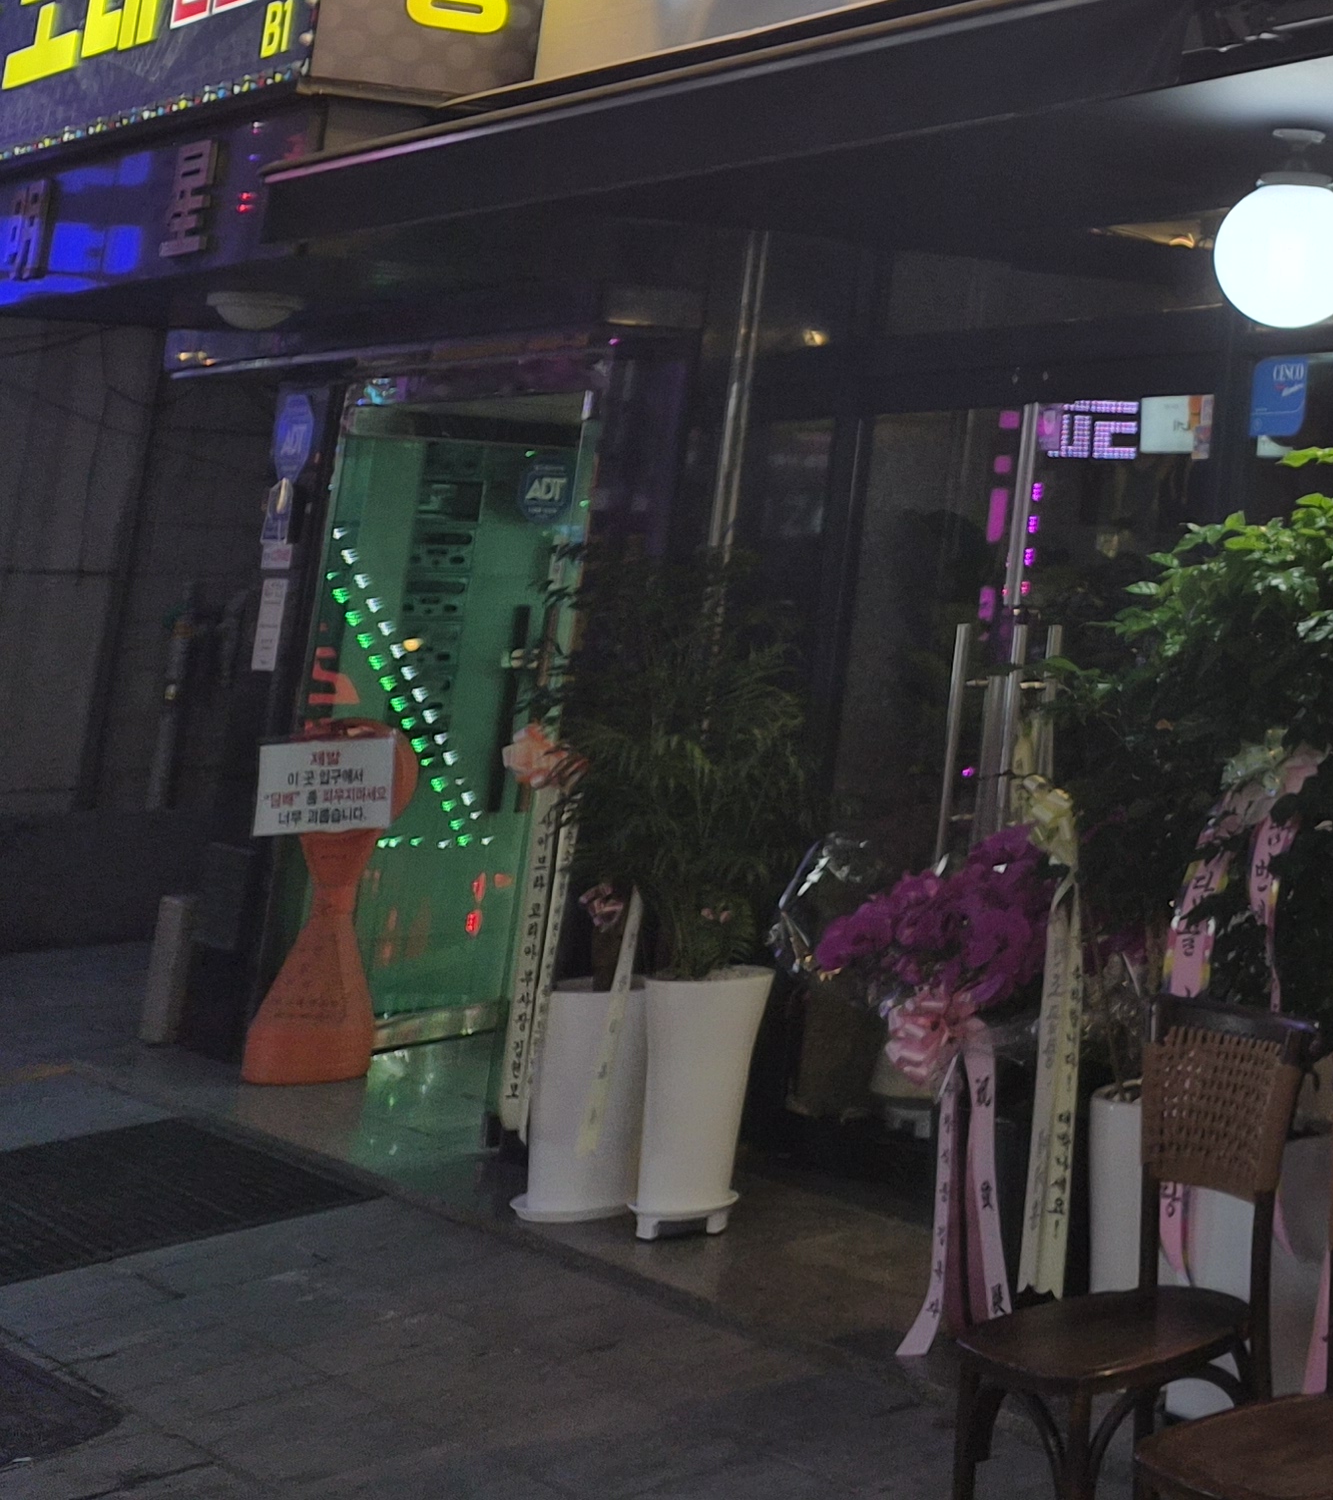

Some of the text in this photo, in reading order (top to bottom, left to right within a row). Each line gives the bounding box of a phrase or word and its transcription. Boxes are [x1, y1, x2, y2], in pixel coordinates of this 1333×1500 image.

[524, 476, 568, 501] ADT
[310, 751, 341, 766] 제발
[278, 810, 302, 826] 너무
